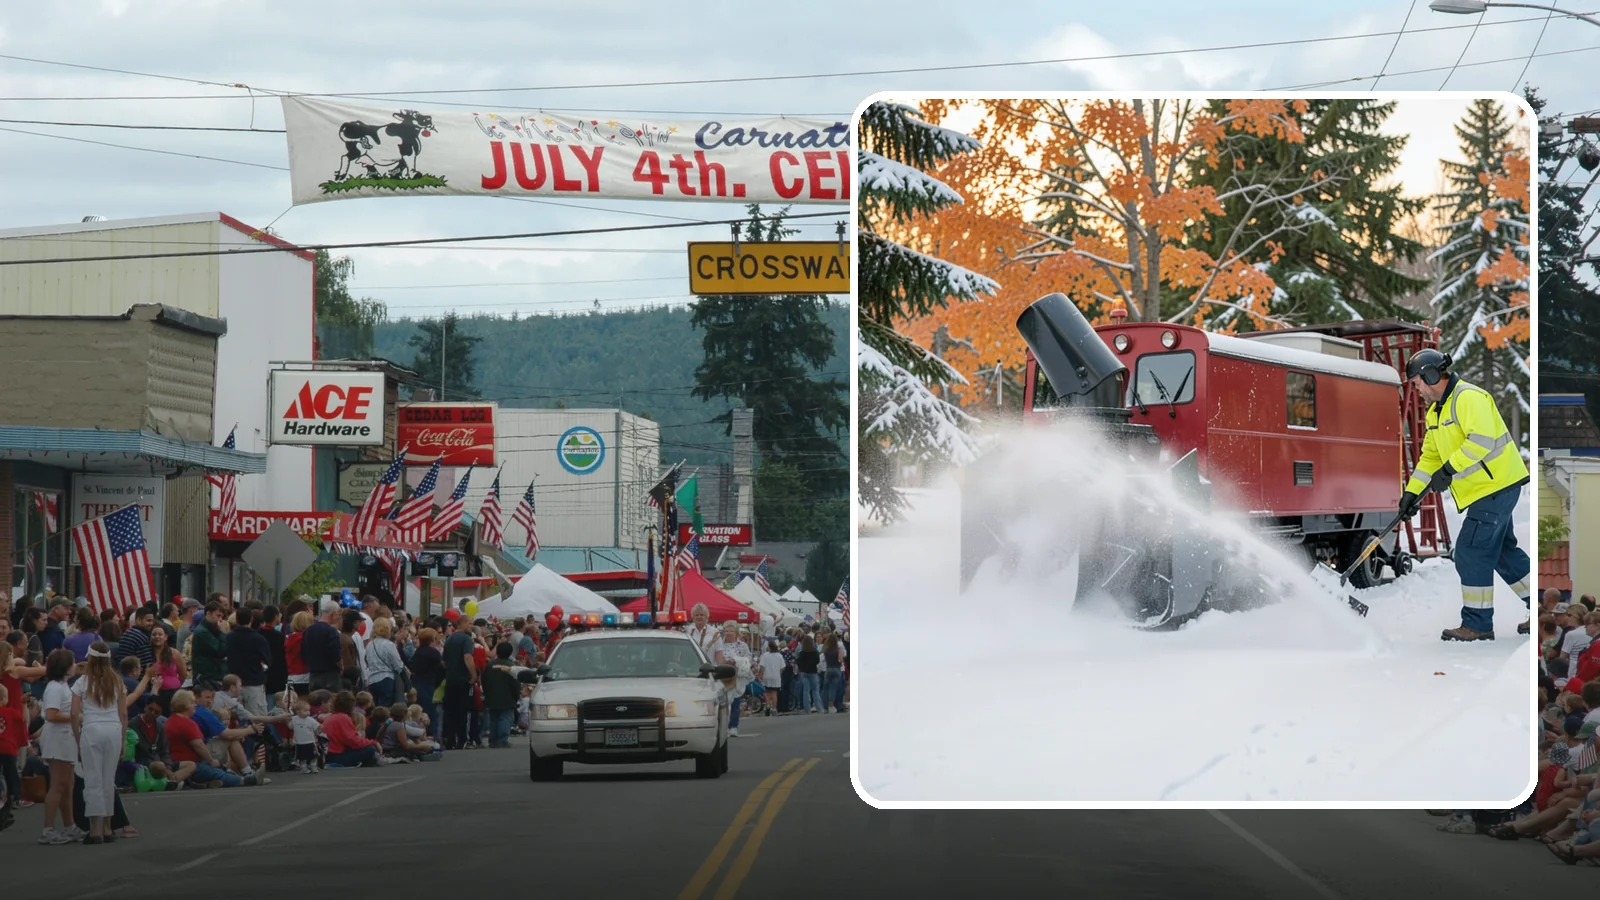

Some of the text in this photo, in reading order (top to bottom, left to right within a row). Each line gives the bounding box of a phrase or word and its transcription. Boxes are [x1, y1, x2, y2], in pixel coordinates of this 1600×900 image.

[695, 121, 850, 150] Carnat
[481, 141, 605, 193] JULY
[632, 150, 747, 198] 4th.
[697, 254, 850, 280] CROSSWA
[283, 380, 373, 420] ACE
[406, 409, 485, 422] CEDAR LOG
[283, 421, 371, 437] Hardware
[416, 427, 478, 447] Coca-Cola
[353, 466, 387, 482] Simpl
[95, 485, 124, 495] Vincent
[126, 486, 136, 495] de
[138, 486, 155, 495] Paul
[212, 516, 330, 536] HARDARE
[688, 526, 742, 535] CRNATION
[699, 535, 730, 543] GLASS
